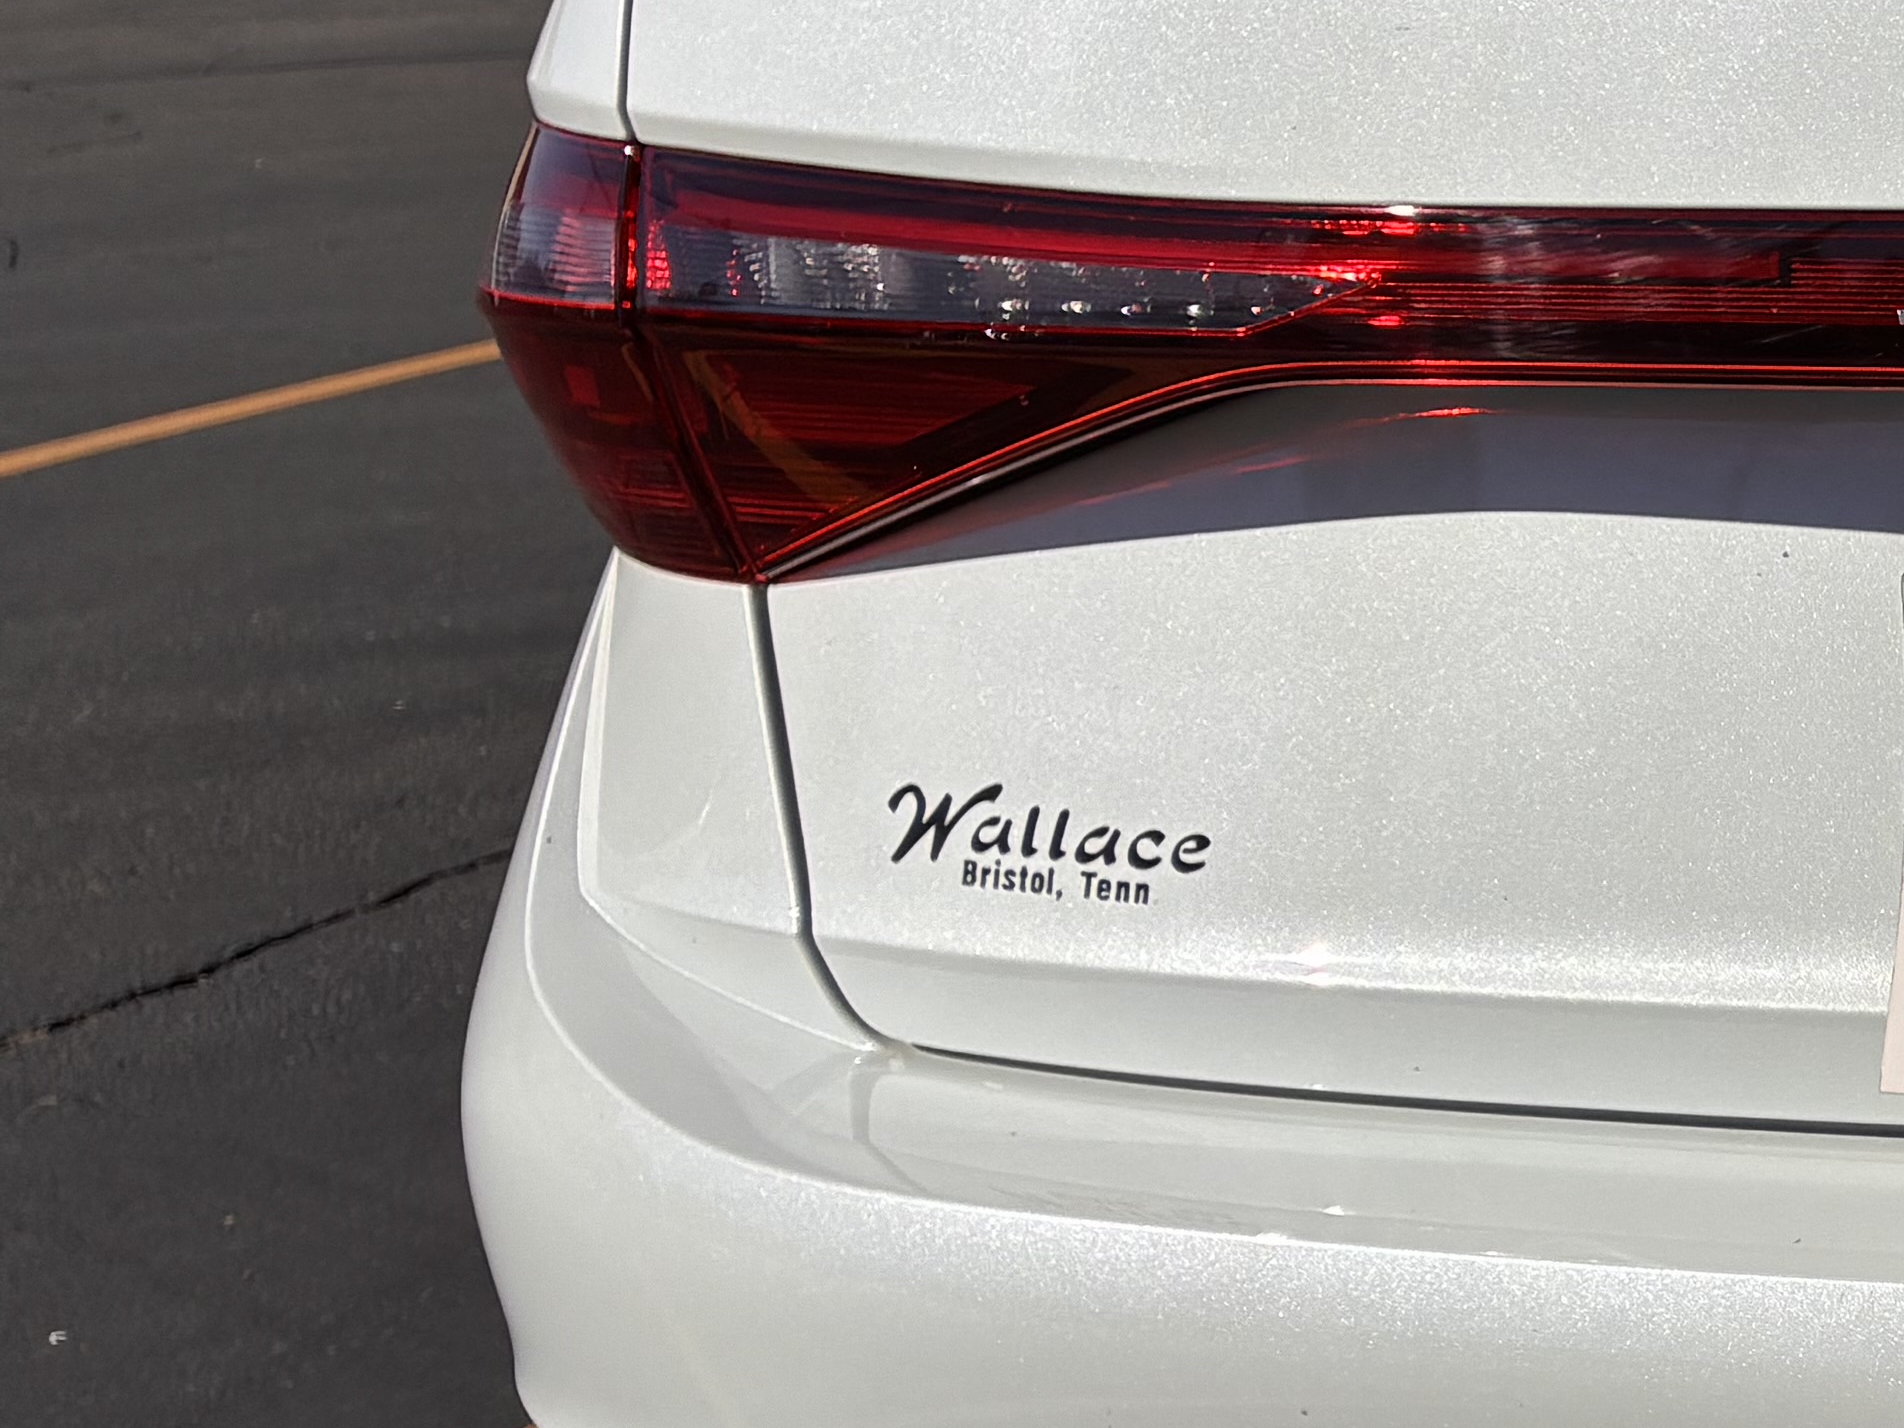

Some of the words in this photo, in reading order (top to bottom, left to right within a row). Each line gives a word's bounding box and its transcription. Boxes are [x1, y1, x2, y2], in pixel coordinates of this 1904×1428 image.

[885, 780, 1213, 874] Wallace
[961, 859, 1063, 901] Bristol,
[1081, 870, 1150, 906] Tenn
